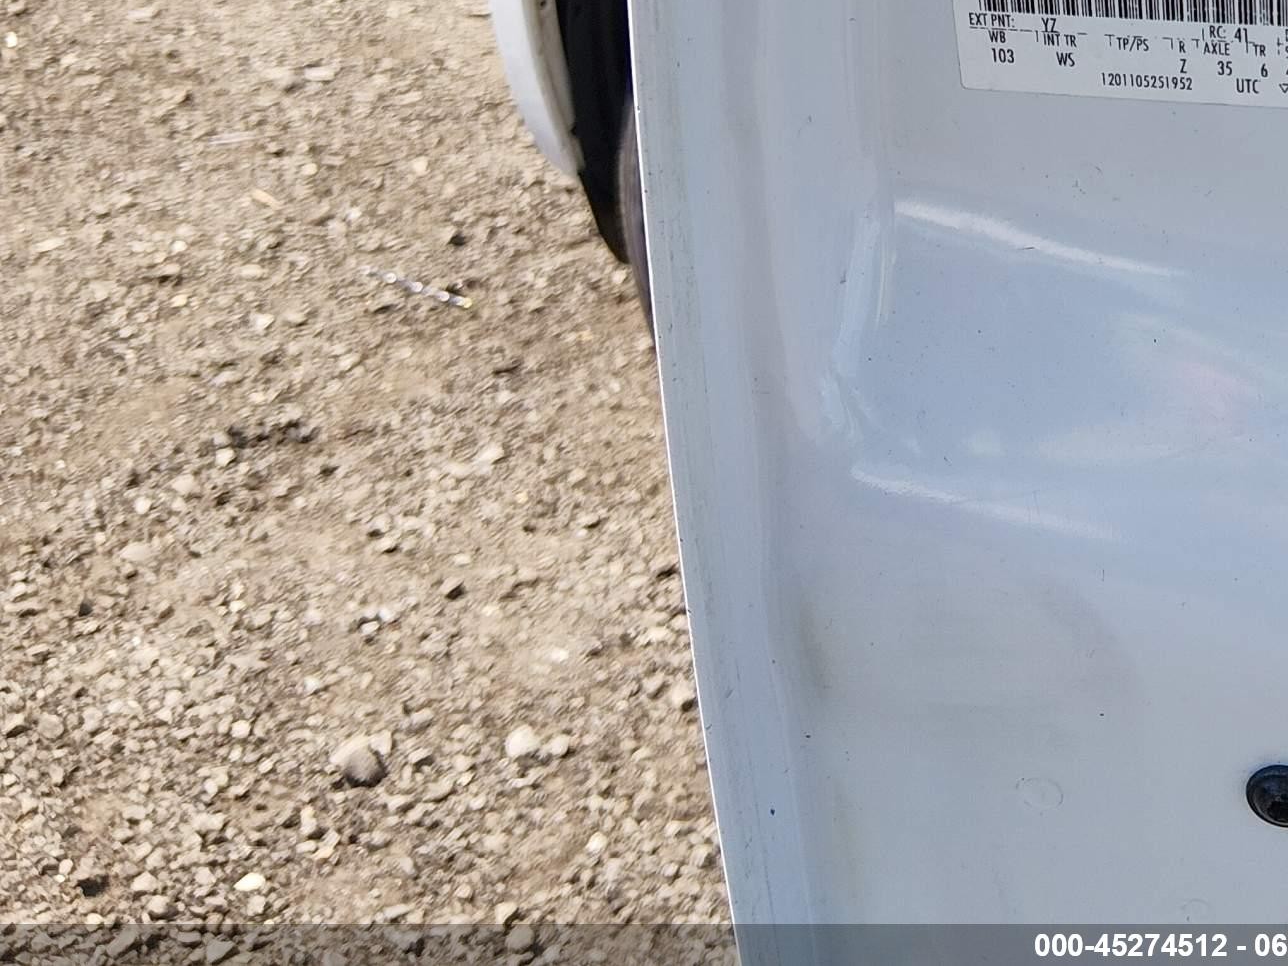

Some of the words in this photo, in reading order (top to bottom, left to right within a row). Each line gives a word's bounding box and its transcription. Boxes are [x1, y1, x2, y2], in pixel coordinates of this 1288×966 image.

[969, 13, 987, 26] EXT
[991, 15, 1014, 28] PNT:
[1042, 18, 1056, 32] YZ
[989, 31, 1006, 43] WB
[1043, 33, 1060, 46] INT
[1064, 35, 1077, 47] TR
[1117, 36, 1149, 52] TP/PS
[1179, 40, 1186, 53] R
[1204, 42, 1230, 56] AXLE
[1252, 44, 1266, 57] TR
[992, 48, 1014, 63] 103
[1056, 53, 1075, 67] WS
[1217, 61, 1232, 76] 35
[1261, 63, 1268, 77] 6
[1102, 72, 1193, 90] 1201105251952
[1236, 79, 1259, 94] UTC
